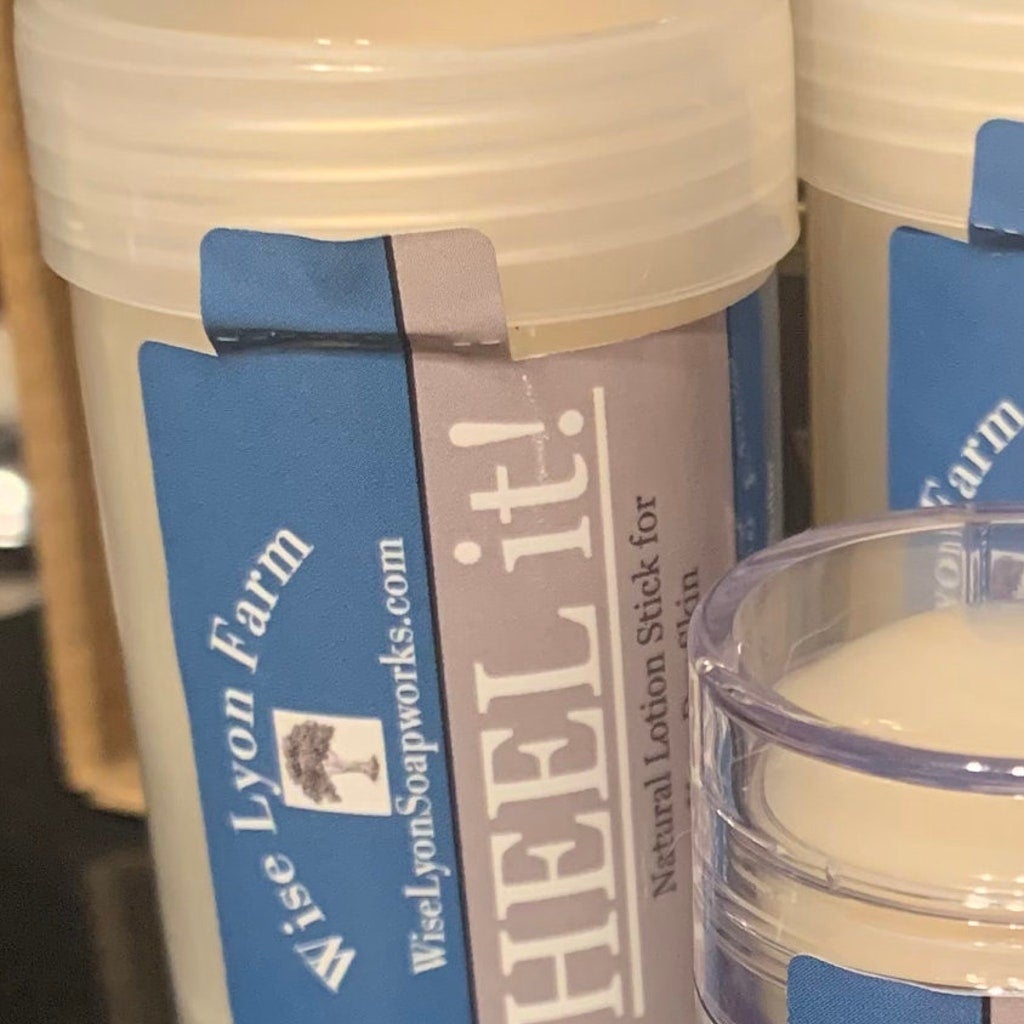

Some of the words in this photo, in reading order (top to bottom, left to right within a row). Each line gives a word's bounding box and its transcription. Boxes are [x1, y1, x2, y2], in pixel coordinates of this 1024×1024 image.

[447, 409, 594, 574] it!
[628, 494, 659, 550] for
[209, 528, 316, 675] Farm
[631, 554, 665, 648] Stick
[224, 687, 282, 834] Lyon
[378, 536, 450, 976] WiseLyonSoapworks.com
[638, 652, 672, 766] Lotion
[643, 770, 678, 899] Natural
[263, 854, 357, 992] Wise
